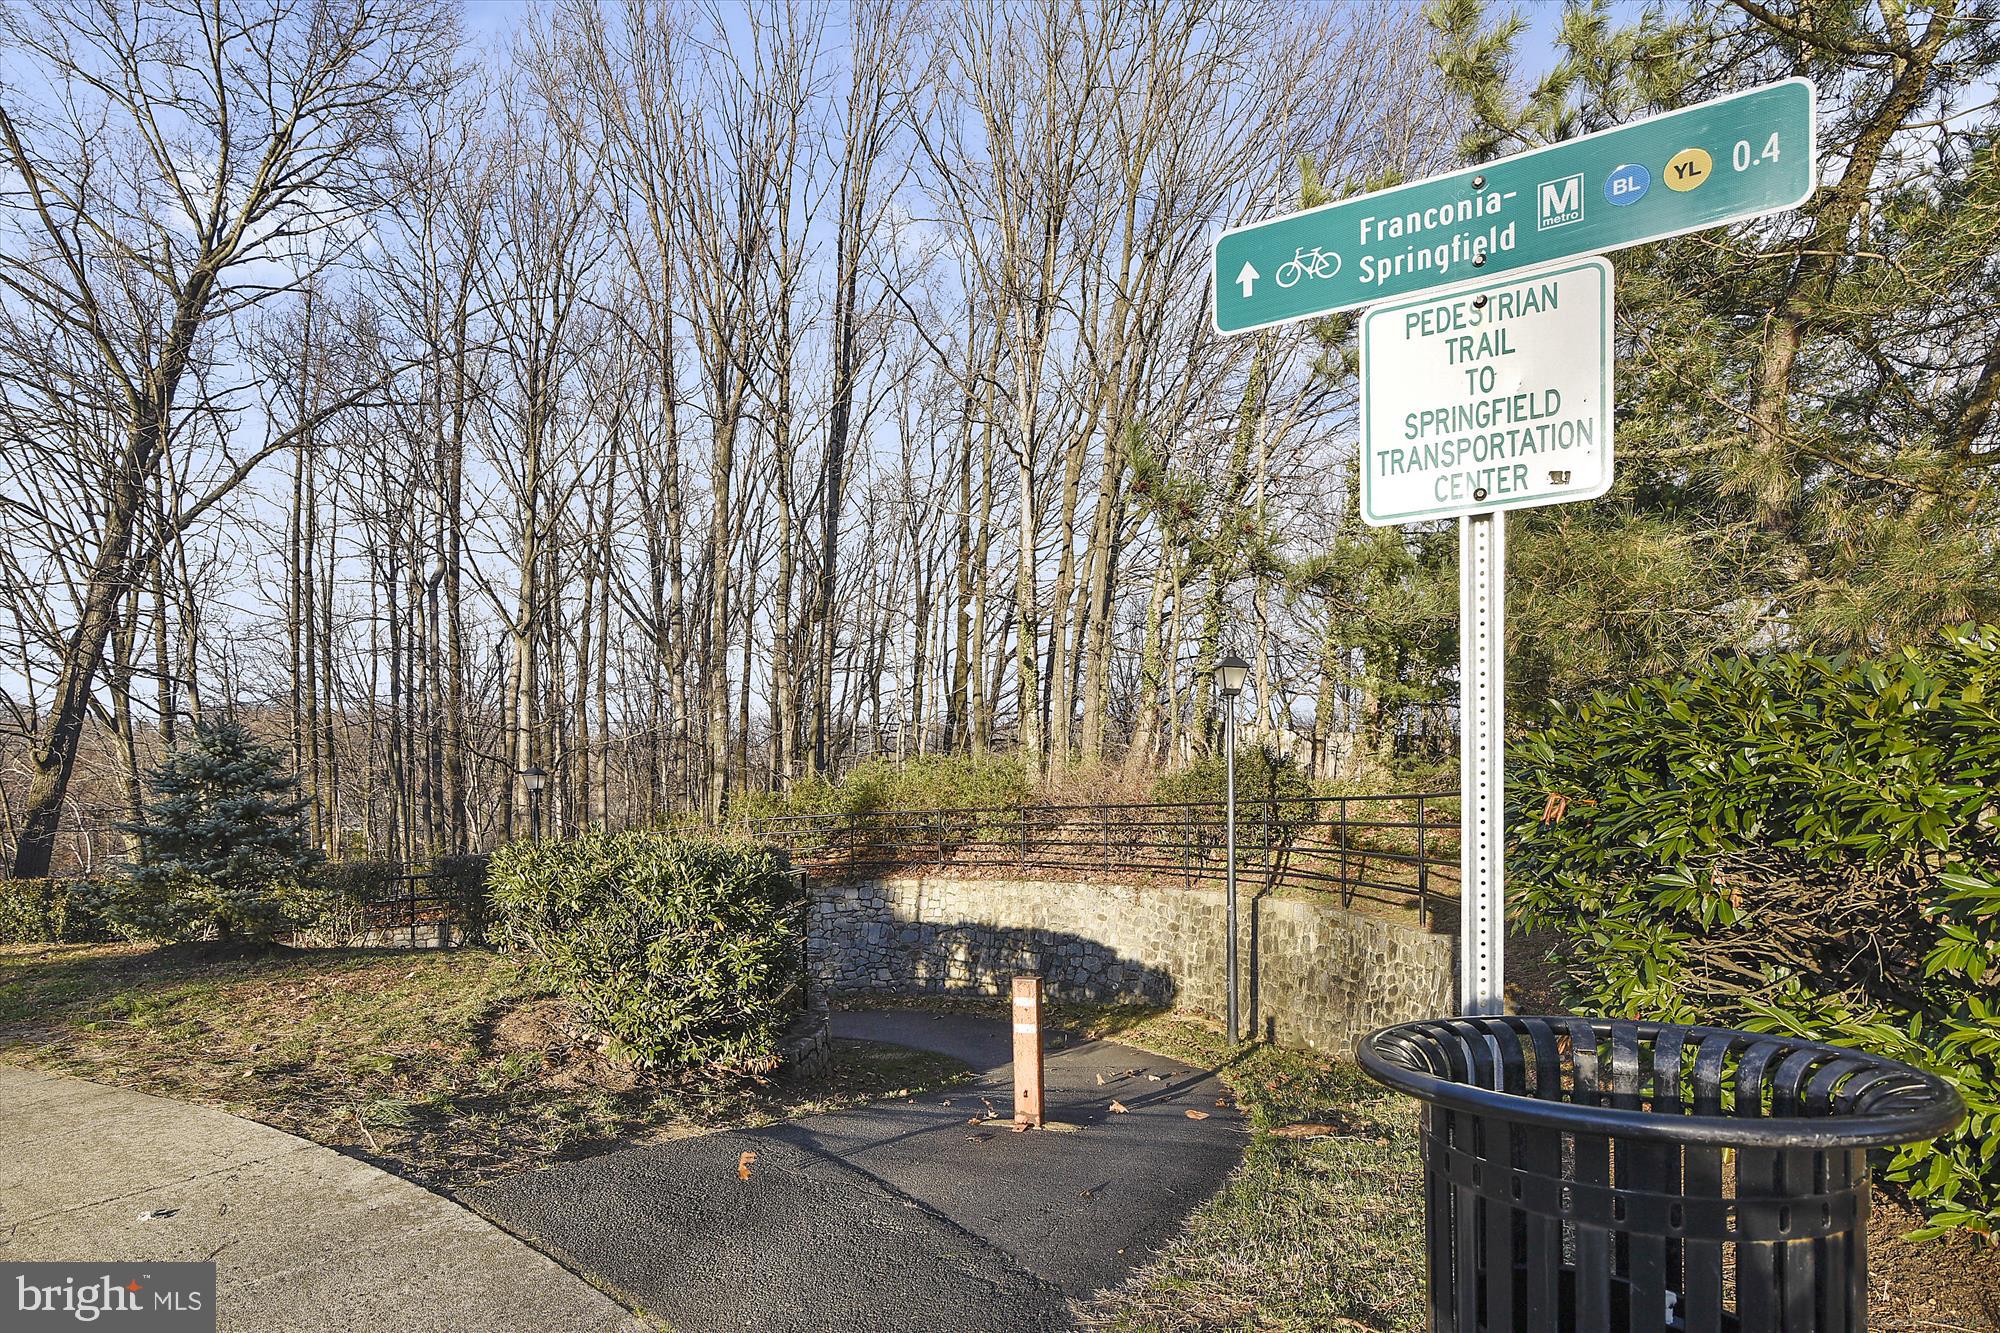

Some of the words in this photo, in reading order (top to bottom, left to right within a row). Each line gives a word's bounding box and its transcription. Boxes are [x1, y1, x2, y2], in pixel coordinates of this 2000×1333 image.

[1612, 177, 1641, 196] BL
[1673, 161, 1702, 179] YL
[1732, 131, 1781, 172] 0.4
[1360, 189, 1517, 246] Franconia-
[1542, 178, 1579, 217] M
[1542, 211, 1579, 227] metro
[1359, 221, 1516, 287] Springfield
[1406, 282, 1558, 340] PEDESTRIAN
[1445, 328, 1516, 365] TRAIL
[1465, 365, 1496, 395] TO
[1404, 389, 1561, 439] SPRINGFIELD
[1377, 417, 1593, 476] TRANSPORTATION
[1434, 463, 1528, 502] CENTER
